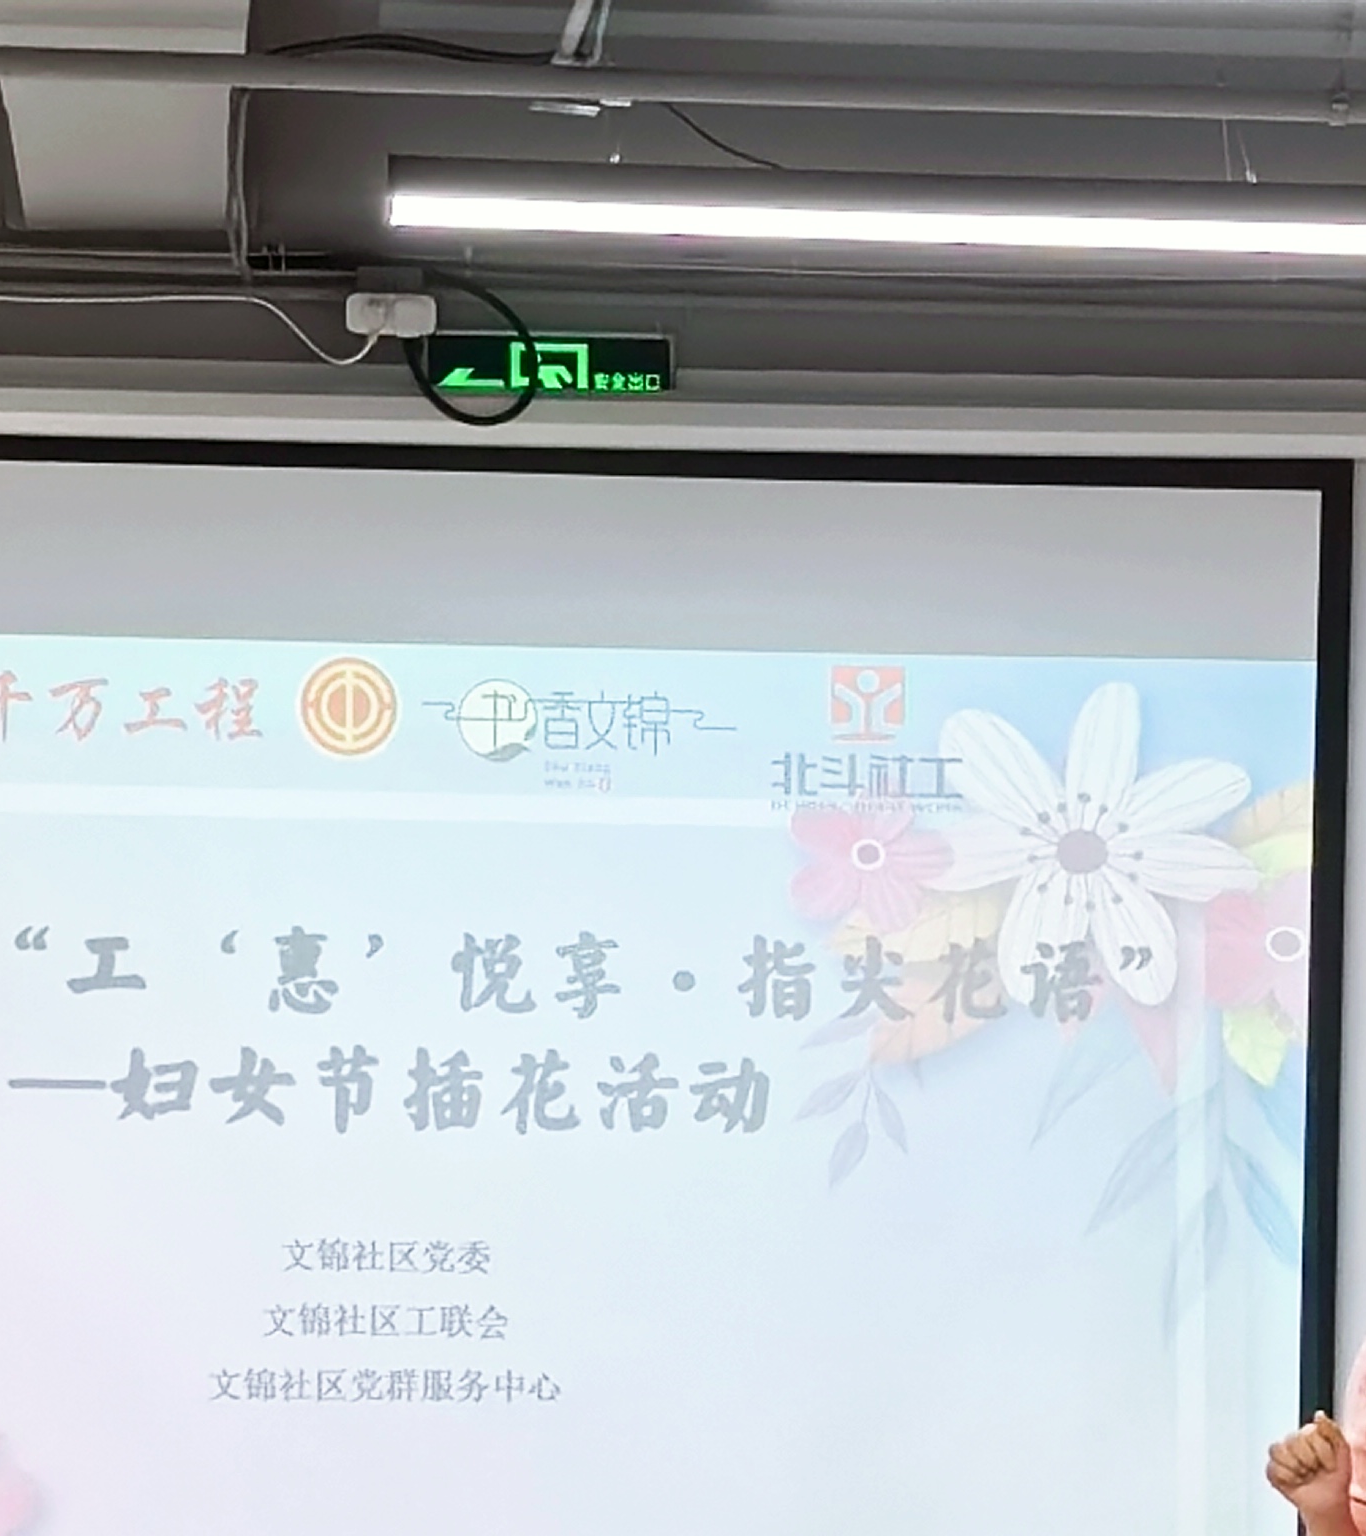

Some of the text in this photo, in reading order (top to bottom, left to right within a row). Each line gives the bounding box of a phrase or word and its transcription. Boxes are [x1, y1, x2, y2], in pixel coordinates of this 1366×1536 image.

[771, 752, 963, 799] 北斗社工
[281, 1238, 491, 1275] 文锦社区党委
[263, 1302, 509, 1341] 文锦社区工联会
[208, 1367, 562, 1403] 文锦社区党群服务中心
